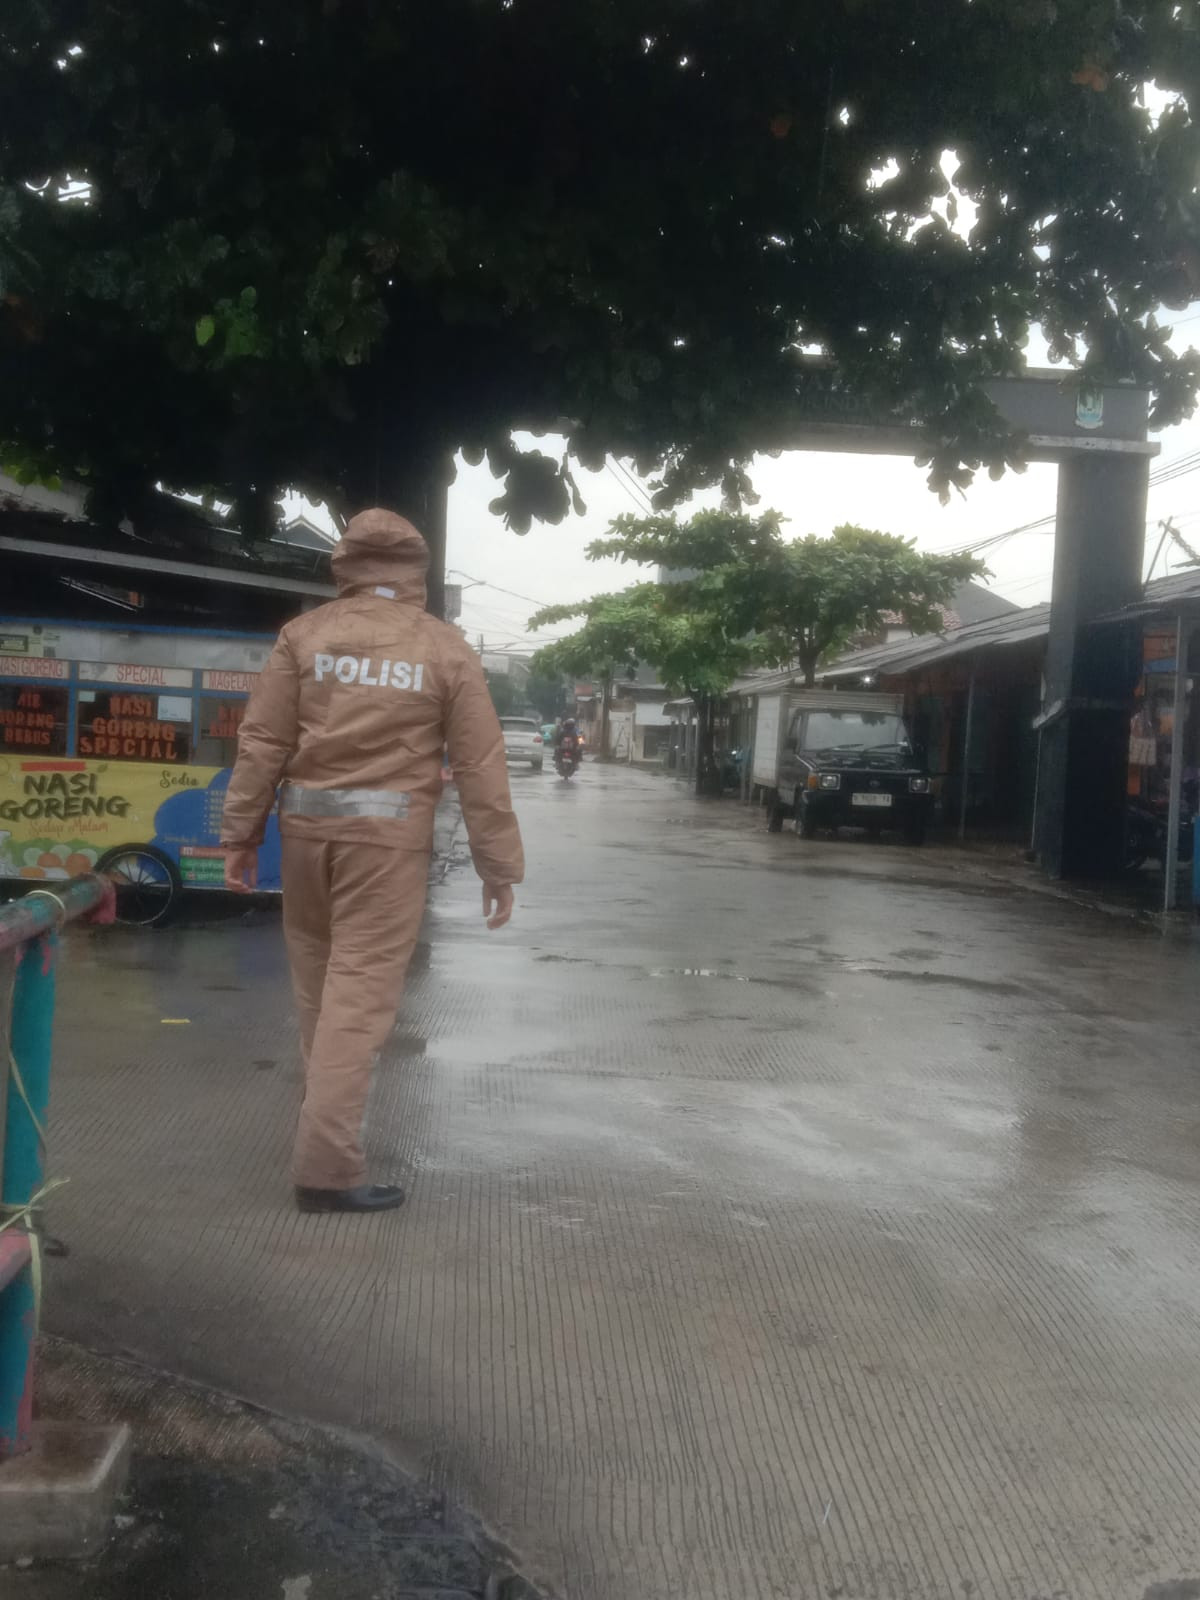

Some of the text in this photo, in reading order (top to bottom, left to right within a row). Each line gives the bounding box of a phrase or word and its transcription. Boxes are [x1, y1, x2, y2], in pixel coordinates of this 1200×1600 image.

[117, 664, 167, 686] SPECIAL
[314, 653, 424, 692] POLISI
[110, 695, 153, 717] NASI
[92, 717, 177, 741] GORENG
[80, 736, 177, 760] SPECIAL
[23, 772, 98, 796] NASI
[160, 769, 199, 789] Sedia
[0, 796, 131, 822] GORENG
